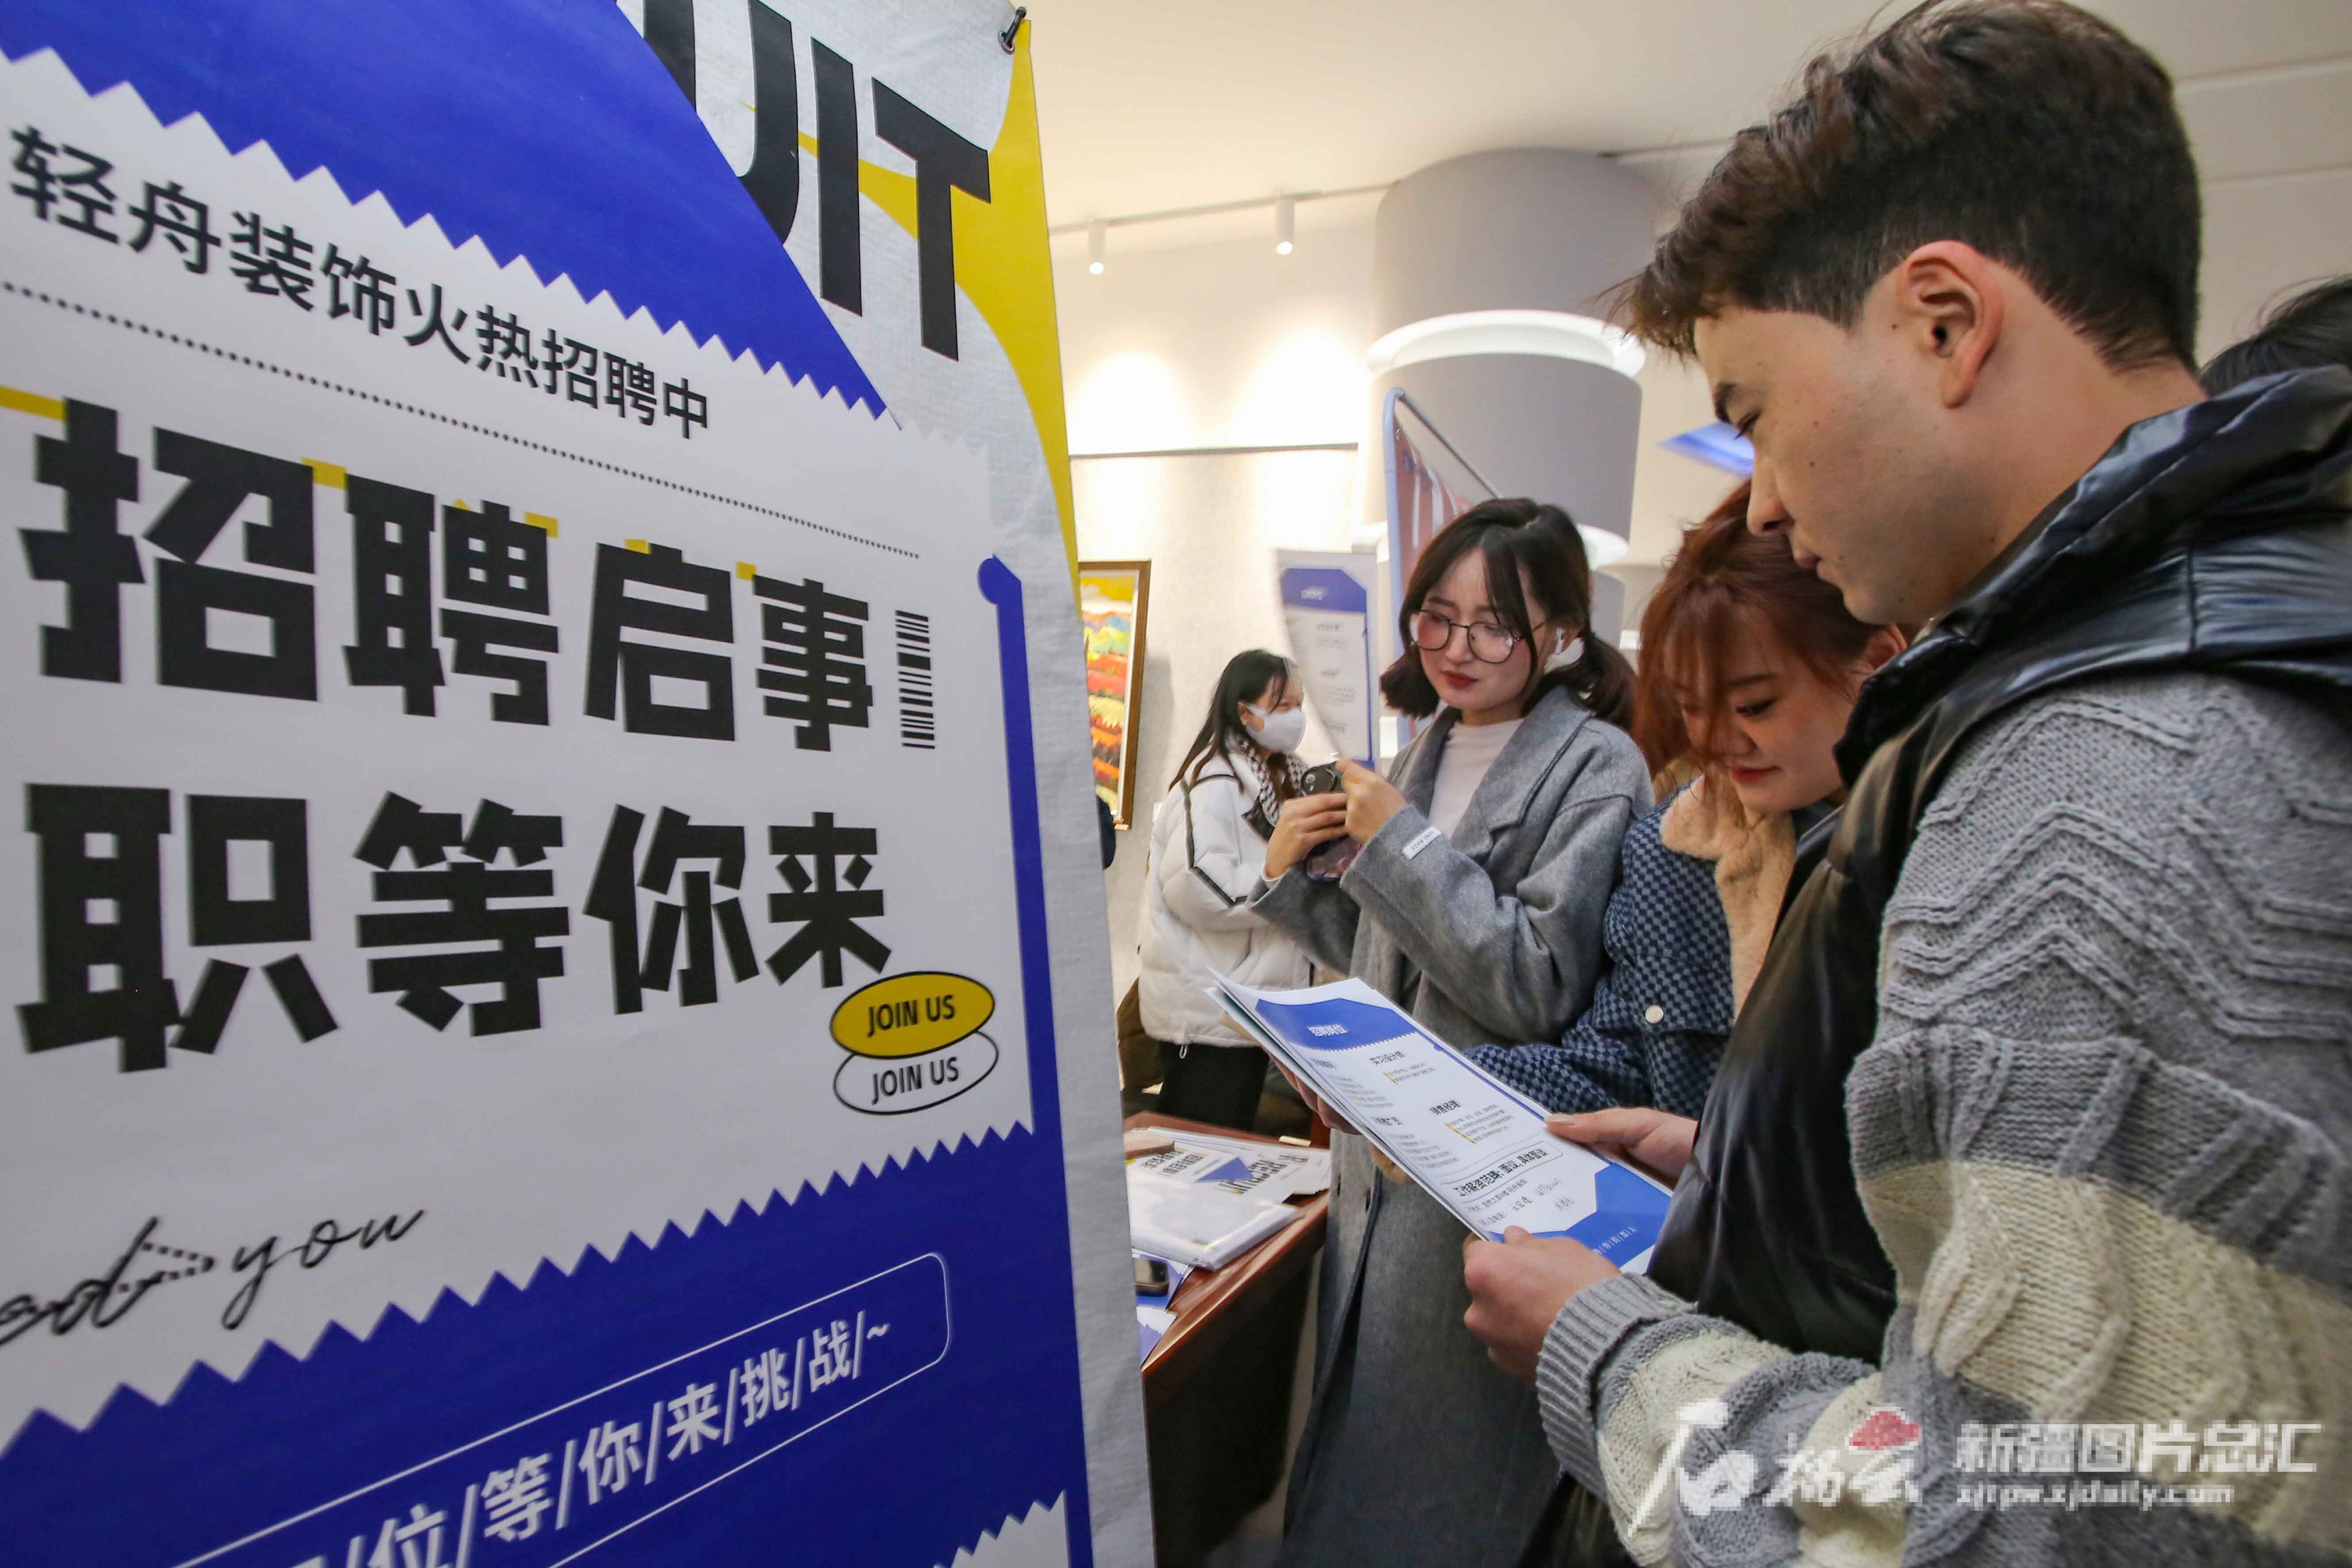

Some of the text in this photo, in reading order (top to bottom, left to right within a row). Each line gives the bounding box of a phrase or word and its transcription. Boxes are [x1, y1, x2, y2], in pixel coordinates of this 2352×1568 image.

[10, 126, 708, 439] 轻舟装饰火热招聘中
[17, 397, 873, 752] 招聘启事
[16, 782, 892, 1073] 职等你来
[866, 994, 956, 1038] JOIN US
[871, 1056, 960, 1106] JOIN US
[220, 1209, 427, 1330] you
